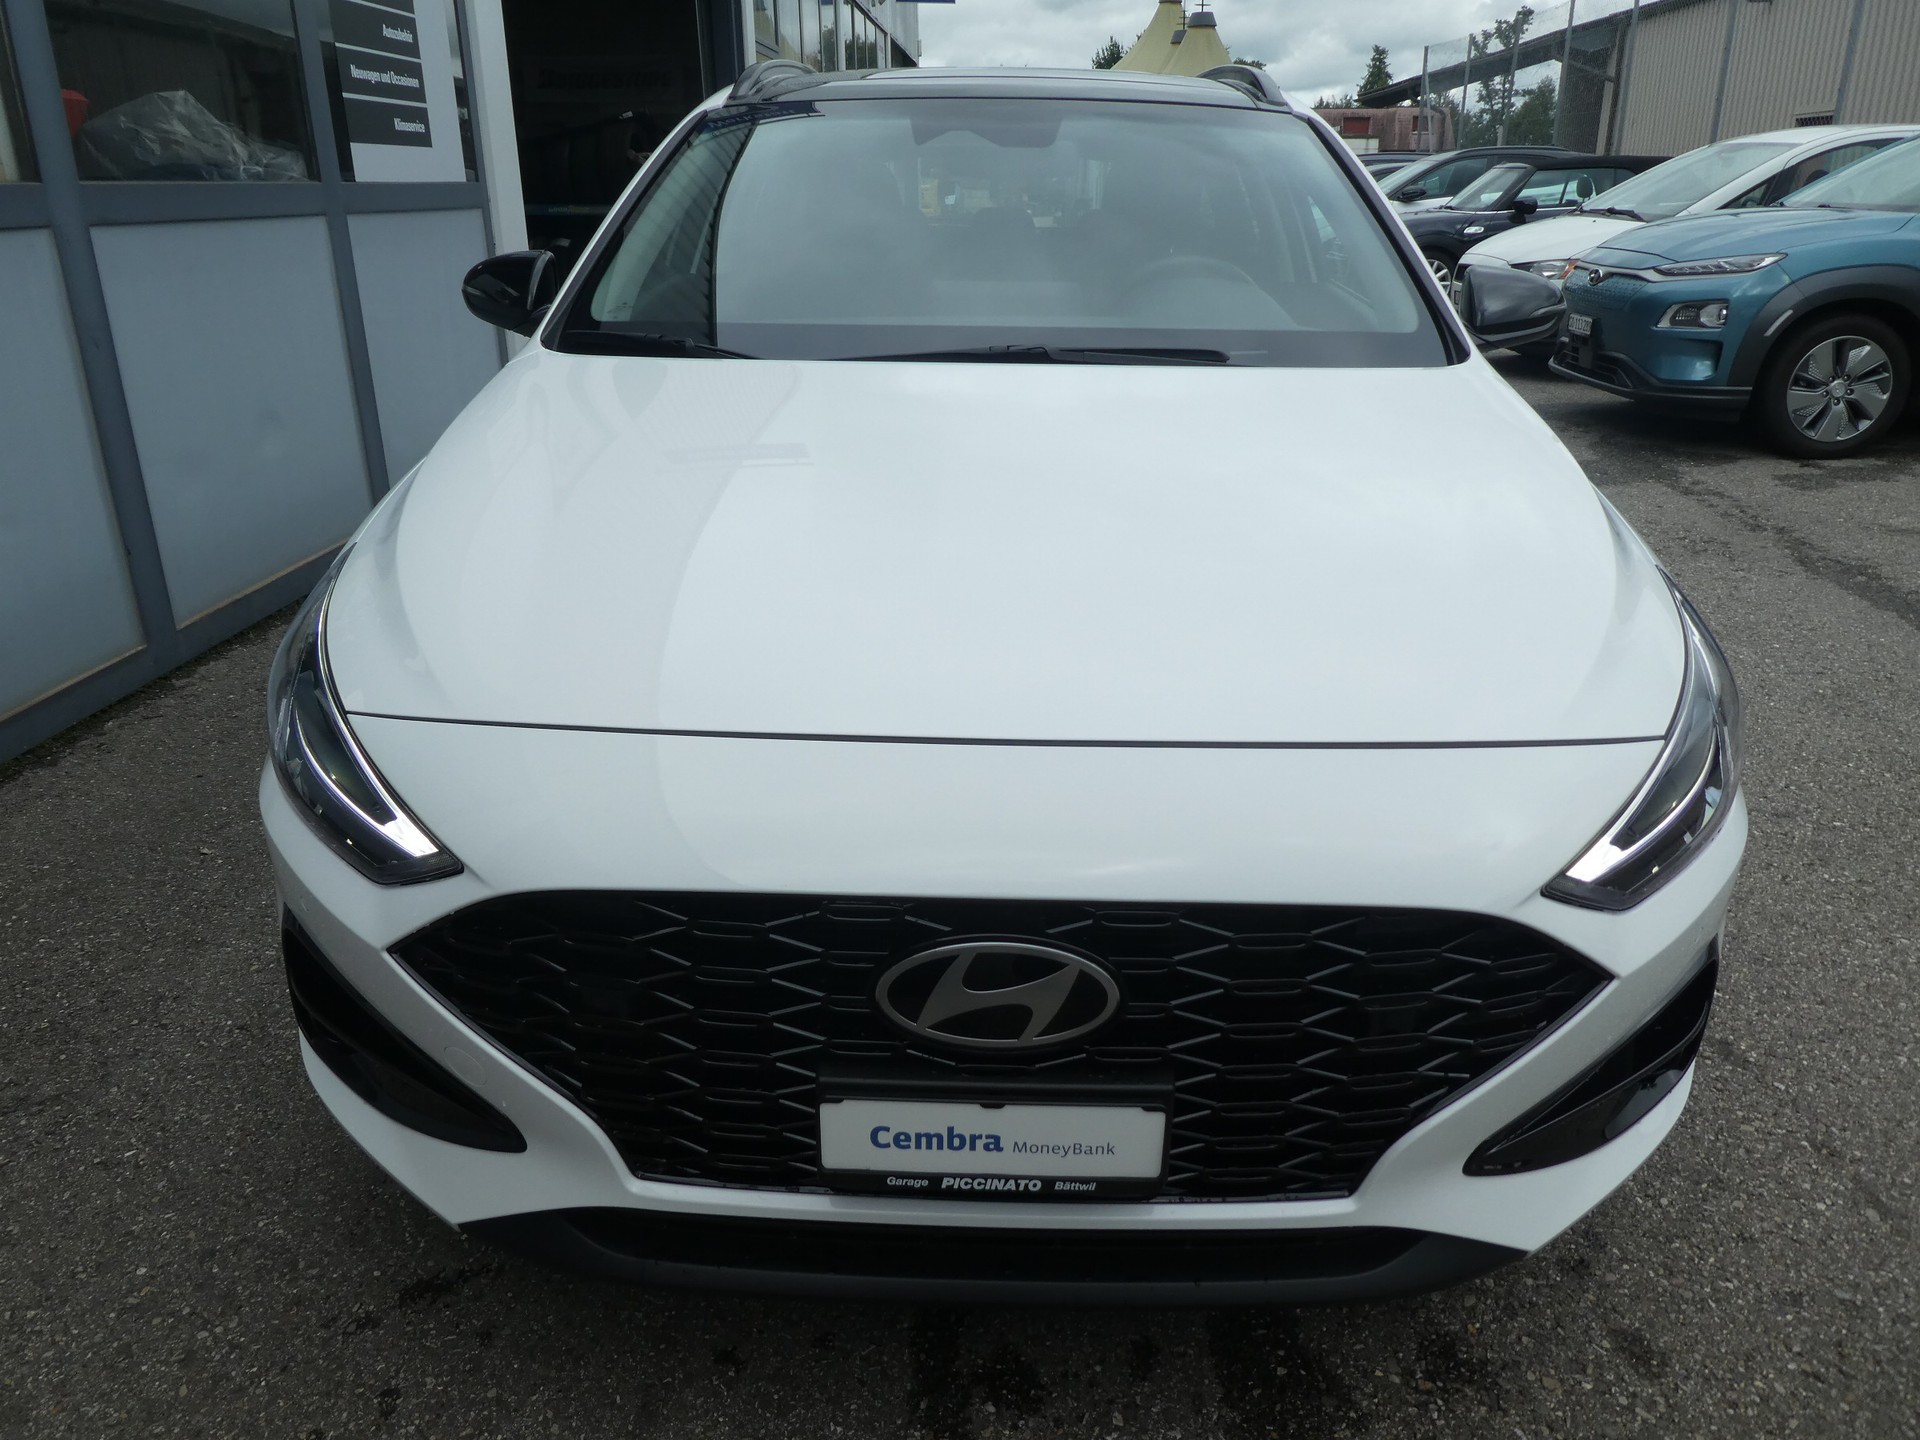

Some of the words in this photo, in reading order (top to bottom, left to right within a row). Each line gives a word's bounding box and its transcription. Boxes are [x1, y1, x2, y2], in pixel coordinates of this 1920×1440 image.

[350, 64, 380, 84] Neuwagen
[380, 70, 391, 84] und
[391, 71, 420, 88] Occasionen
[394, 118, 426, 134] Klimaservice
[869, 1125, 1004, 1153] Cembra
[1012, 1141, 1116, 1158] MoneyBank
[886, 1176, 929, 1188] Garage
[941, 1177, 1043, 1192] PICCINATO
[1054, 1180, 1097, 1192] Bättwil
